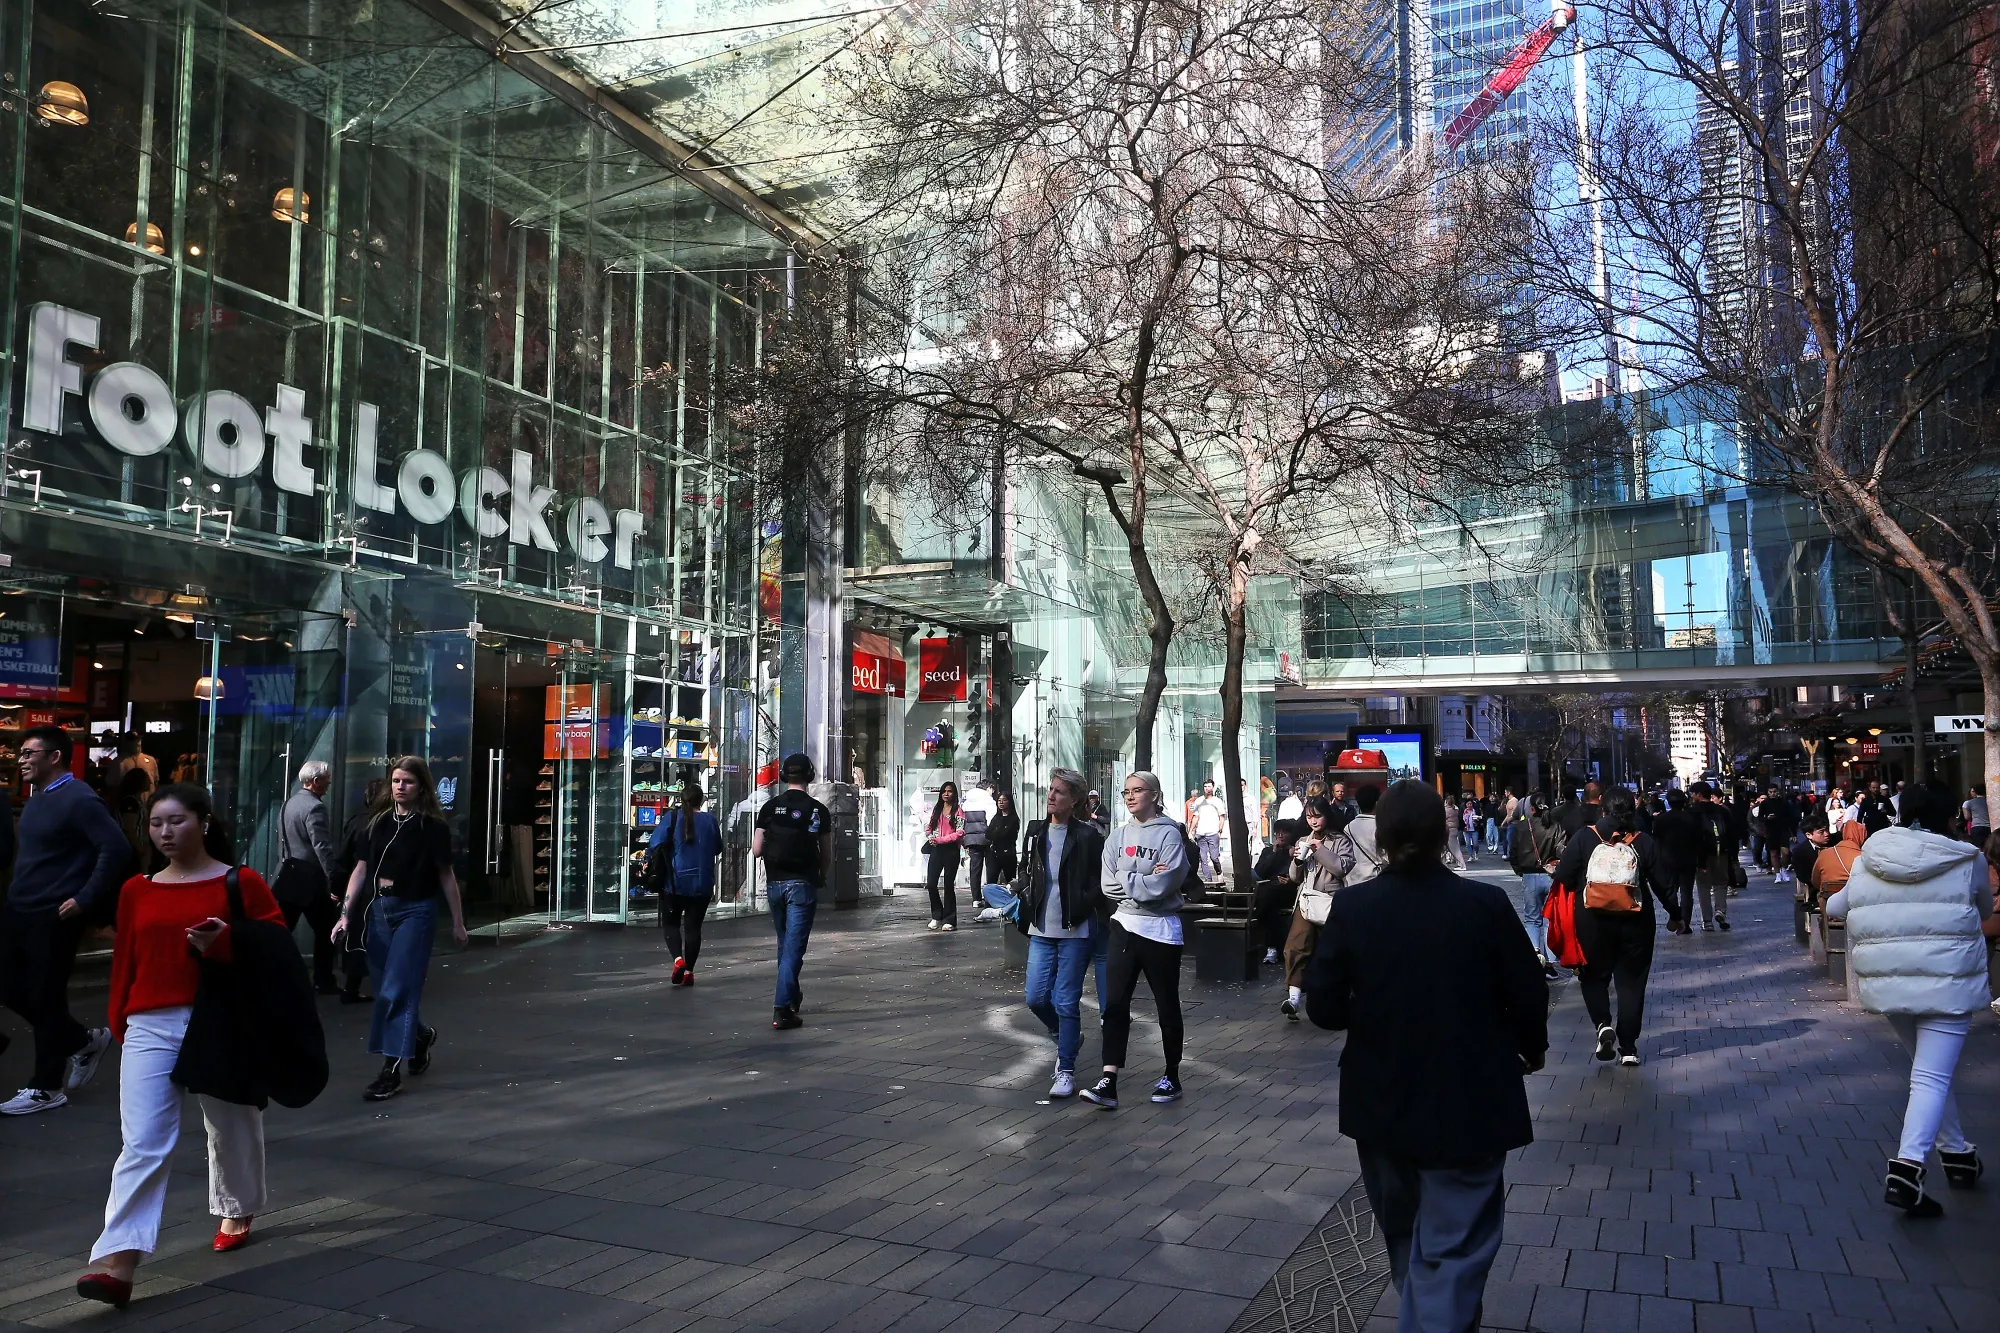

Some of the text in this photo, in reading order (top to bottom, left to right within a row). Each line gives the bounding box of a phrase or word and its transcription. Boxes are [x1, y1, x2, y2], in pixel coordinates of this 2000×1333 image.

[193, 309, 223, 324] SLE
[22, 301, 646, 571] Foot Locker
[0, 619, 46, 633] OMEN'S
[394, 663, 426, 675] WOMEN'S
[924, 665, 961, 682] seed
[393, 685, 413, 695] MEN'S
[31, 714, 53, 723] SALE
[145, 721, 171, 733] MEN
[1136, 845, 1158, 861] NY
